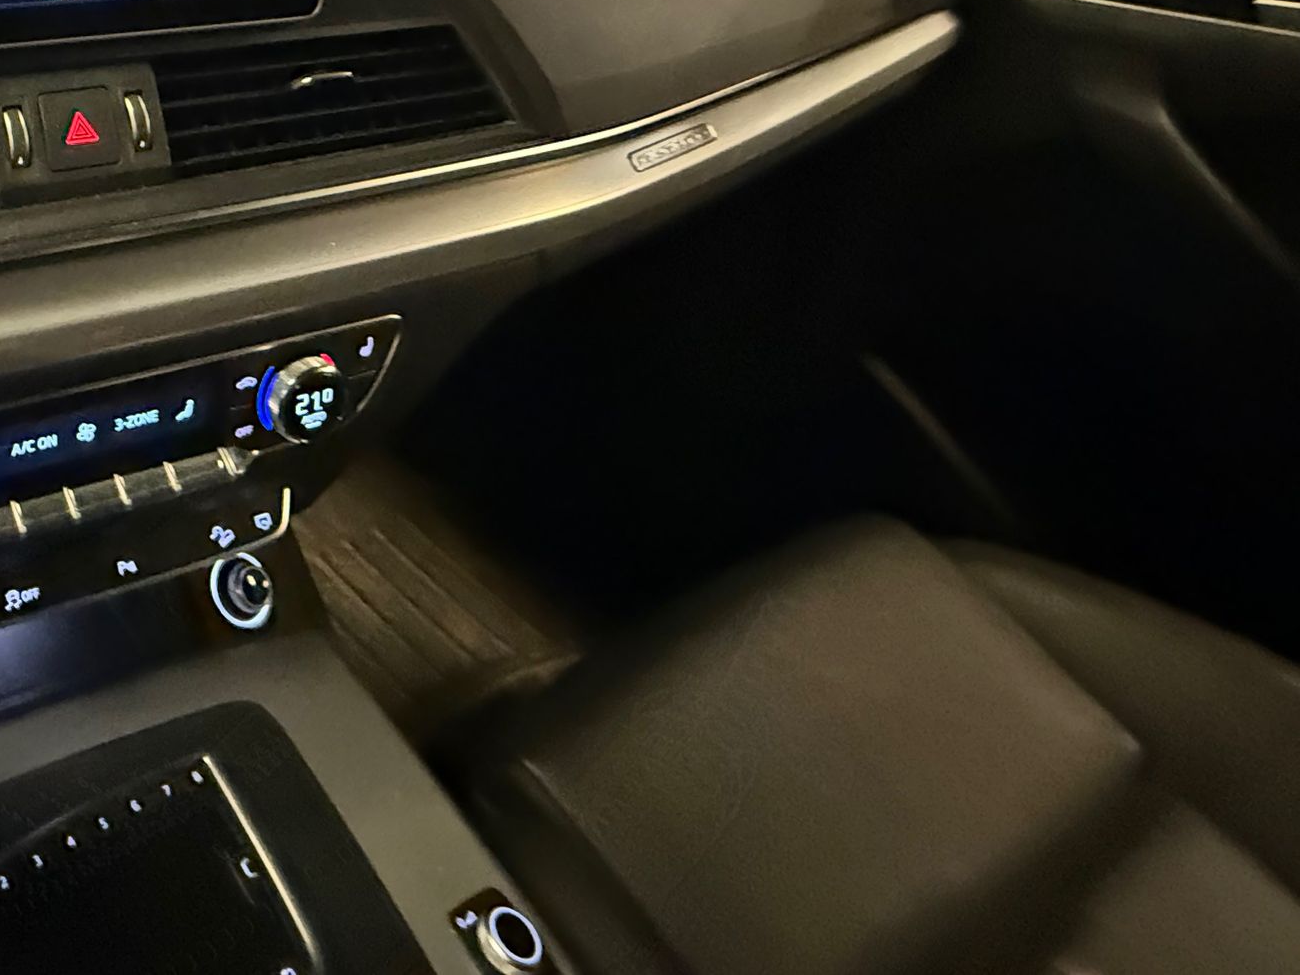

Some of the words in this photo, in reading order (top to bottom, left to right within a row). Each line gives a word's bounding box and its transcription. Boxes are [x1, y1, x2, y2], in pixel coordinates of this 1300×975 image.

[113, 409, 160, 432] 3-ZONE
[11, 439, 36, 457] A/C
[37, 434, 58, 451] ON
